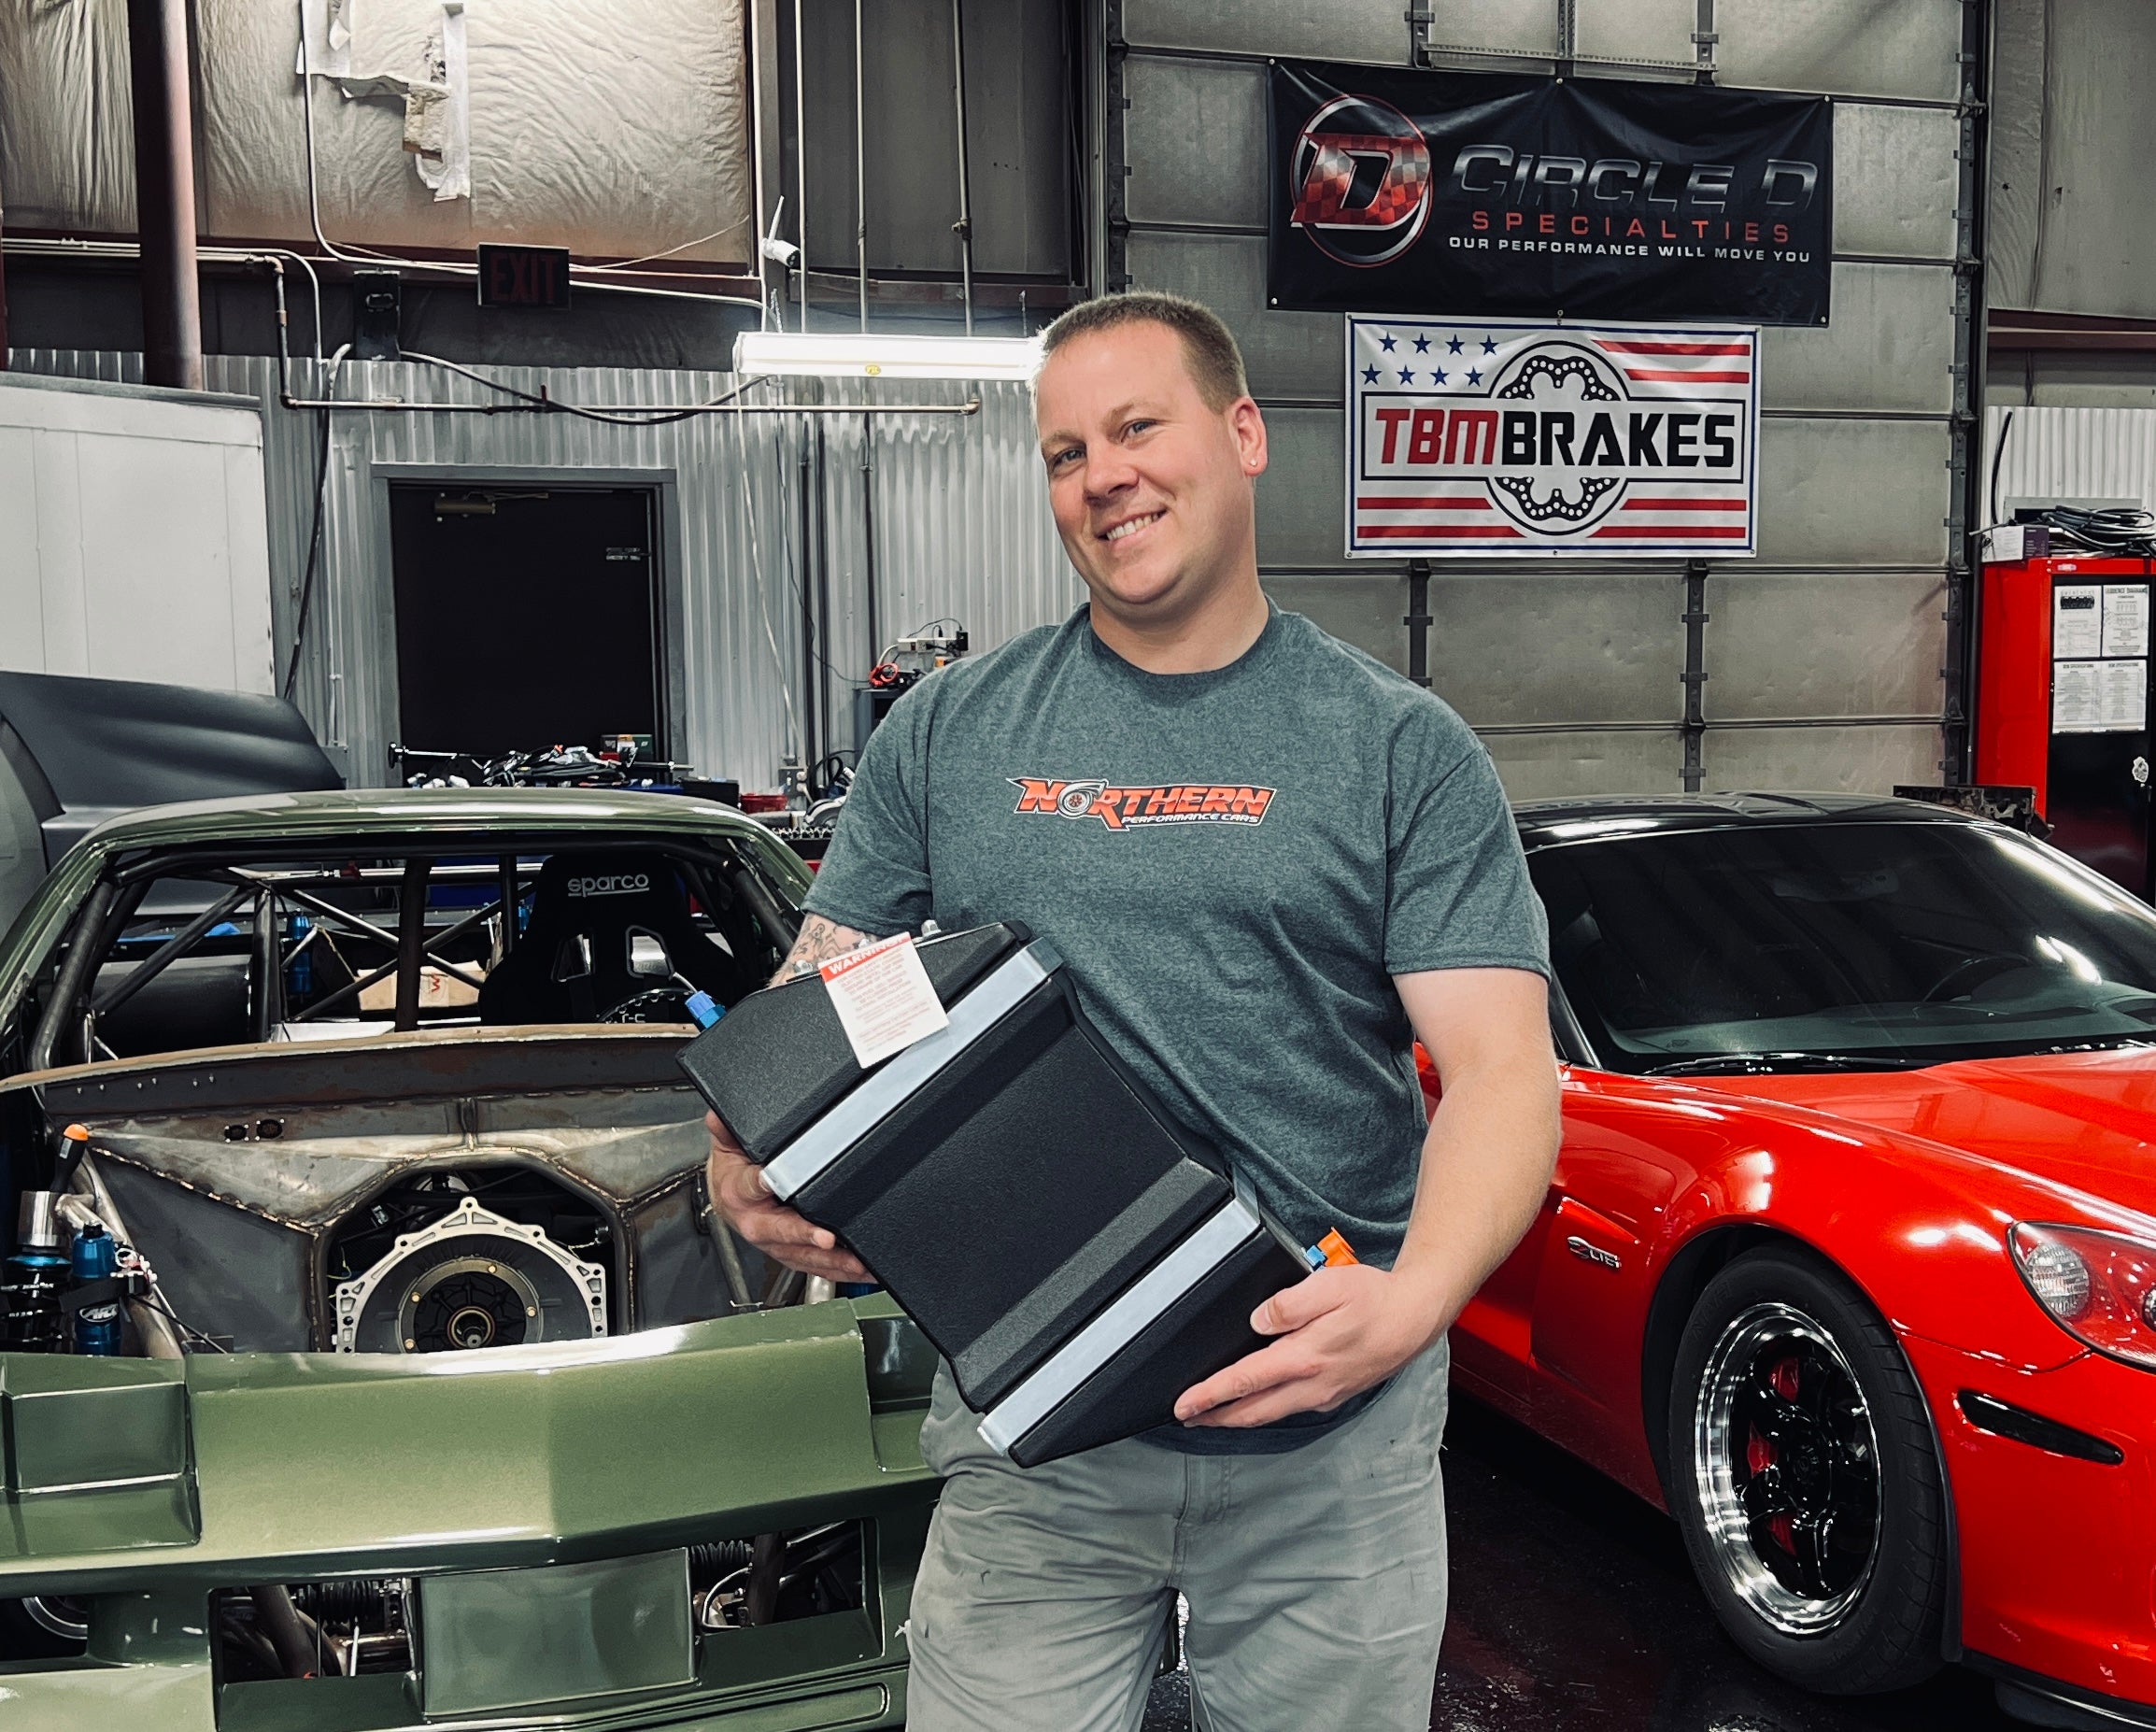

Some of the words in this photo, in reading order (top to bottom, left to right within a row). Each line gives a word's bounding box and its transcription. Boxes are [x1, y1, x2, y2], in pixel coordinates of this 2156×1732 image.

[1452, 144, 1736, 213] CIRCLE
[1762, 159, 1819, 210] D
[1472, 211, 1790, 243] SPECIALTIES
[1449, 236, 1490, 249] OUR
[1498, 239, 1649, 256] PERFORMANCE
[1658, 246, 1706, 258] WILL
[1714, 248, 1765, 261] MOVE
[1773, 250, 1810, 263] YOU
[490, 252, 559, 304] EXIT
[1121, 813, 1219, 824] PERFORMANCE
[1221, 814, 1259, 824] CARS
[567, 873, 650, 897] sparco
